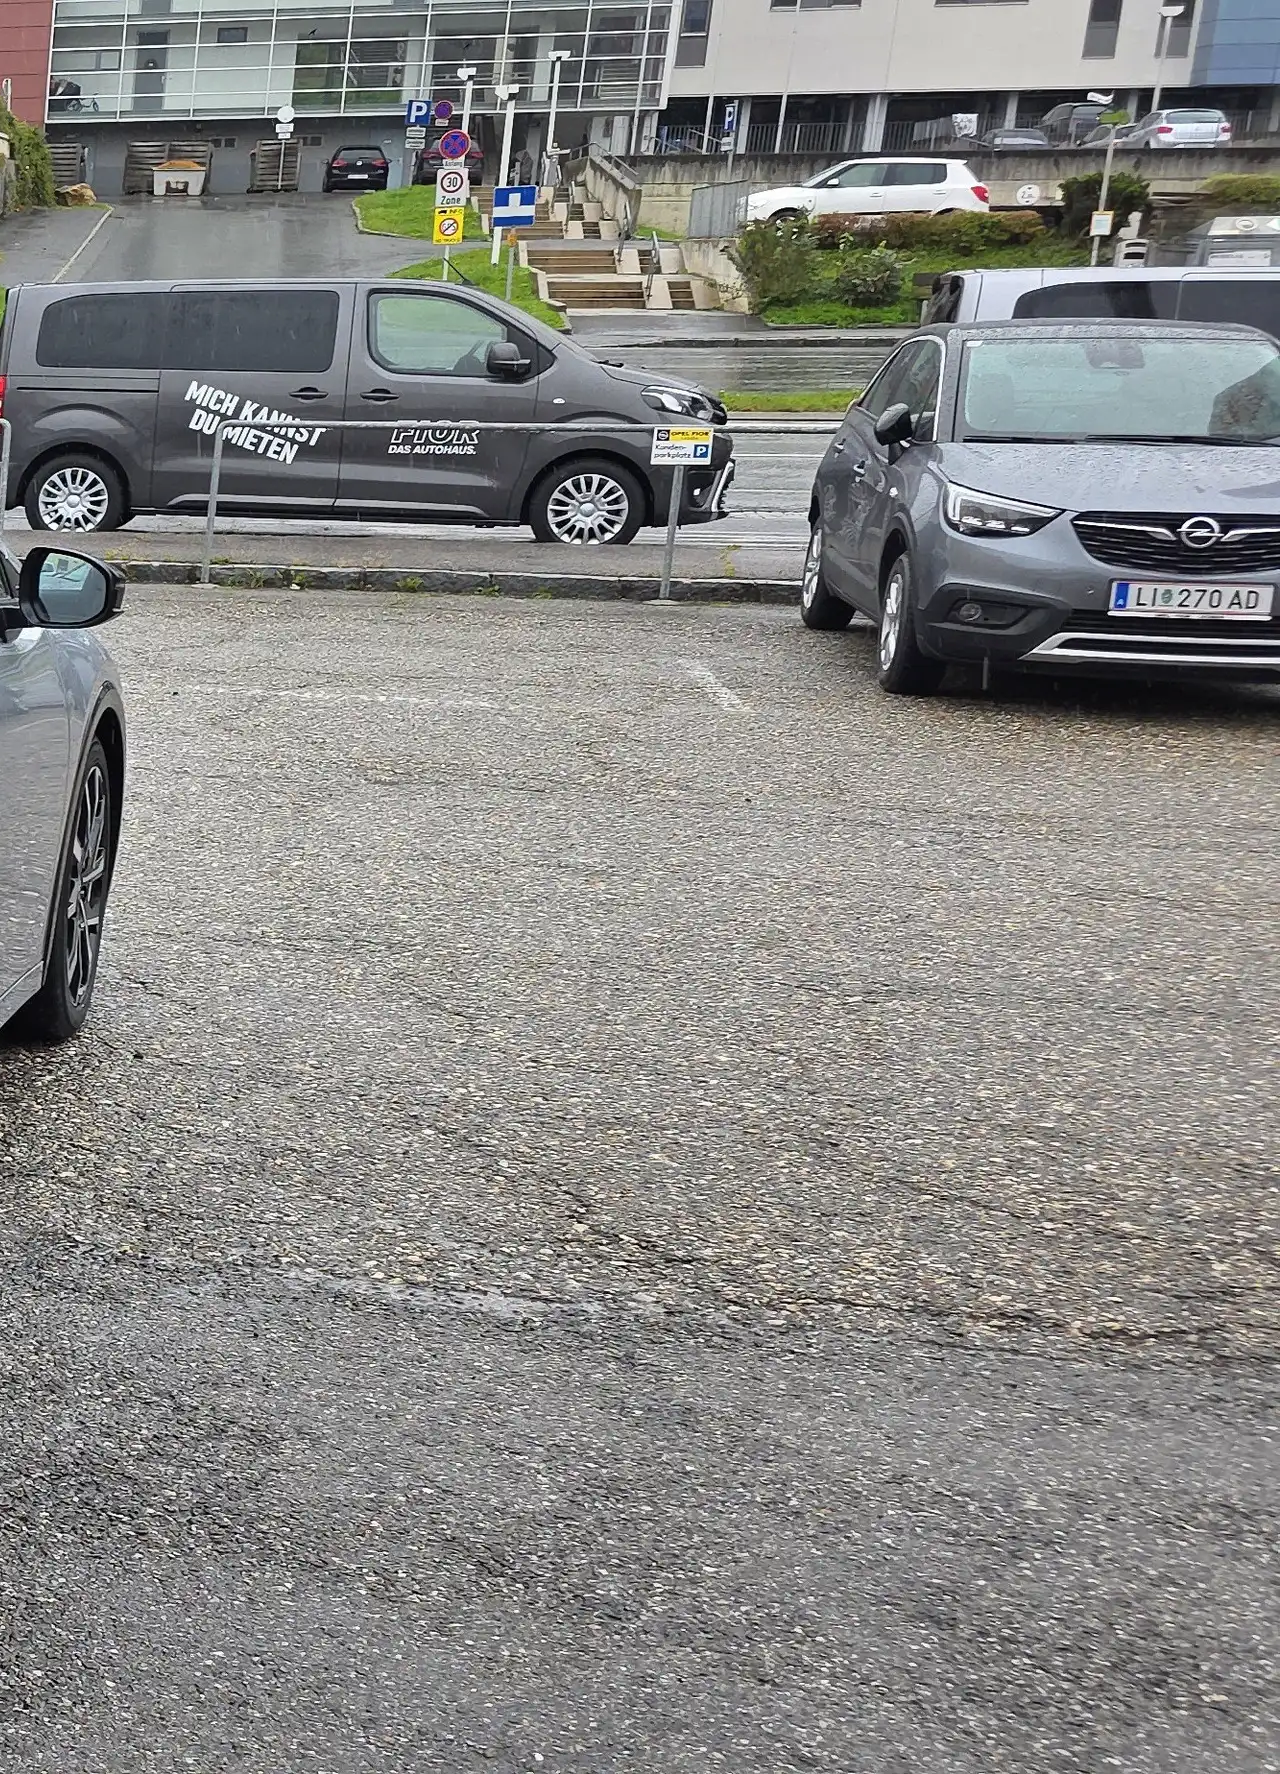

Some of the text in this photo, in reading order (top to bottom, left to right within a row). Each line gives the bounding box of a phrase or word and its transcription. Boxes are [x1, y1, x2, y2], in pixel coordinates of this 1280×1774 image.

[409, 101, 428, 123] P
[446, 177, 458, 188] 30
[440, 196, 461, 205] Zone
[184, 380, 240, 417] MICH
[189, 408, 300, 465] DU MIETEN
[390, 419, 481, 445] FIOR
[387, 445, 477, 455] DAS AUTOHAUS.
[1136, 587, 1260, 610] LI 270 AD
